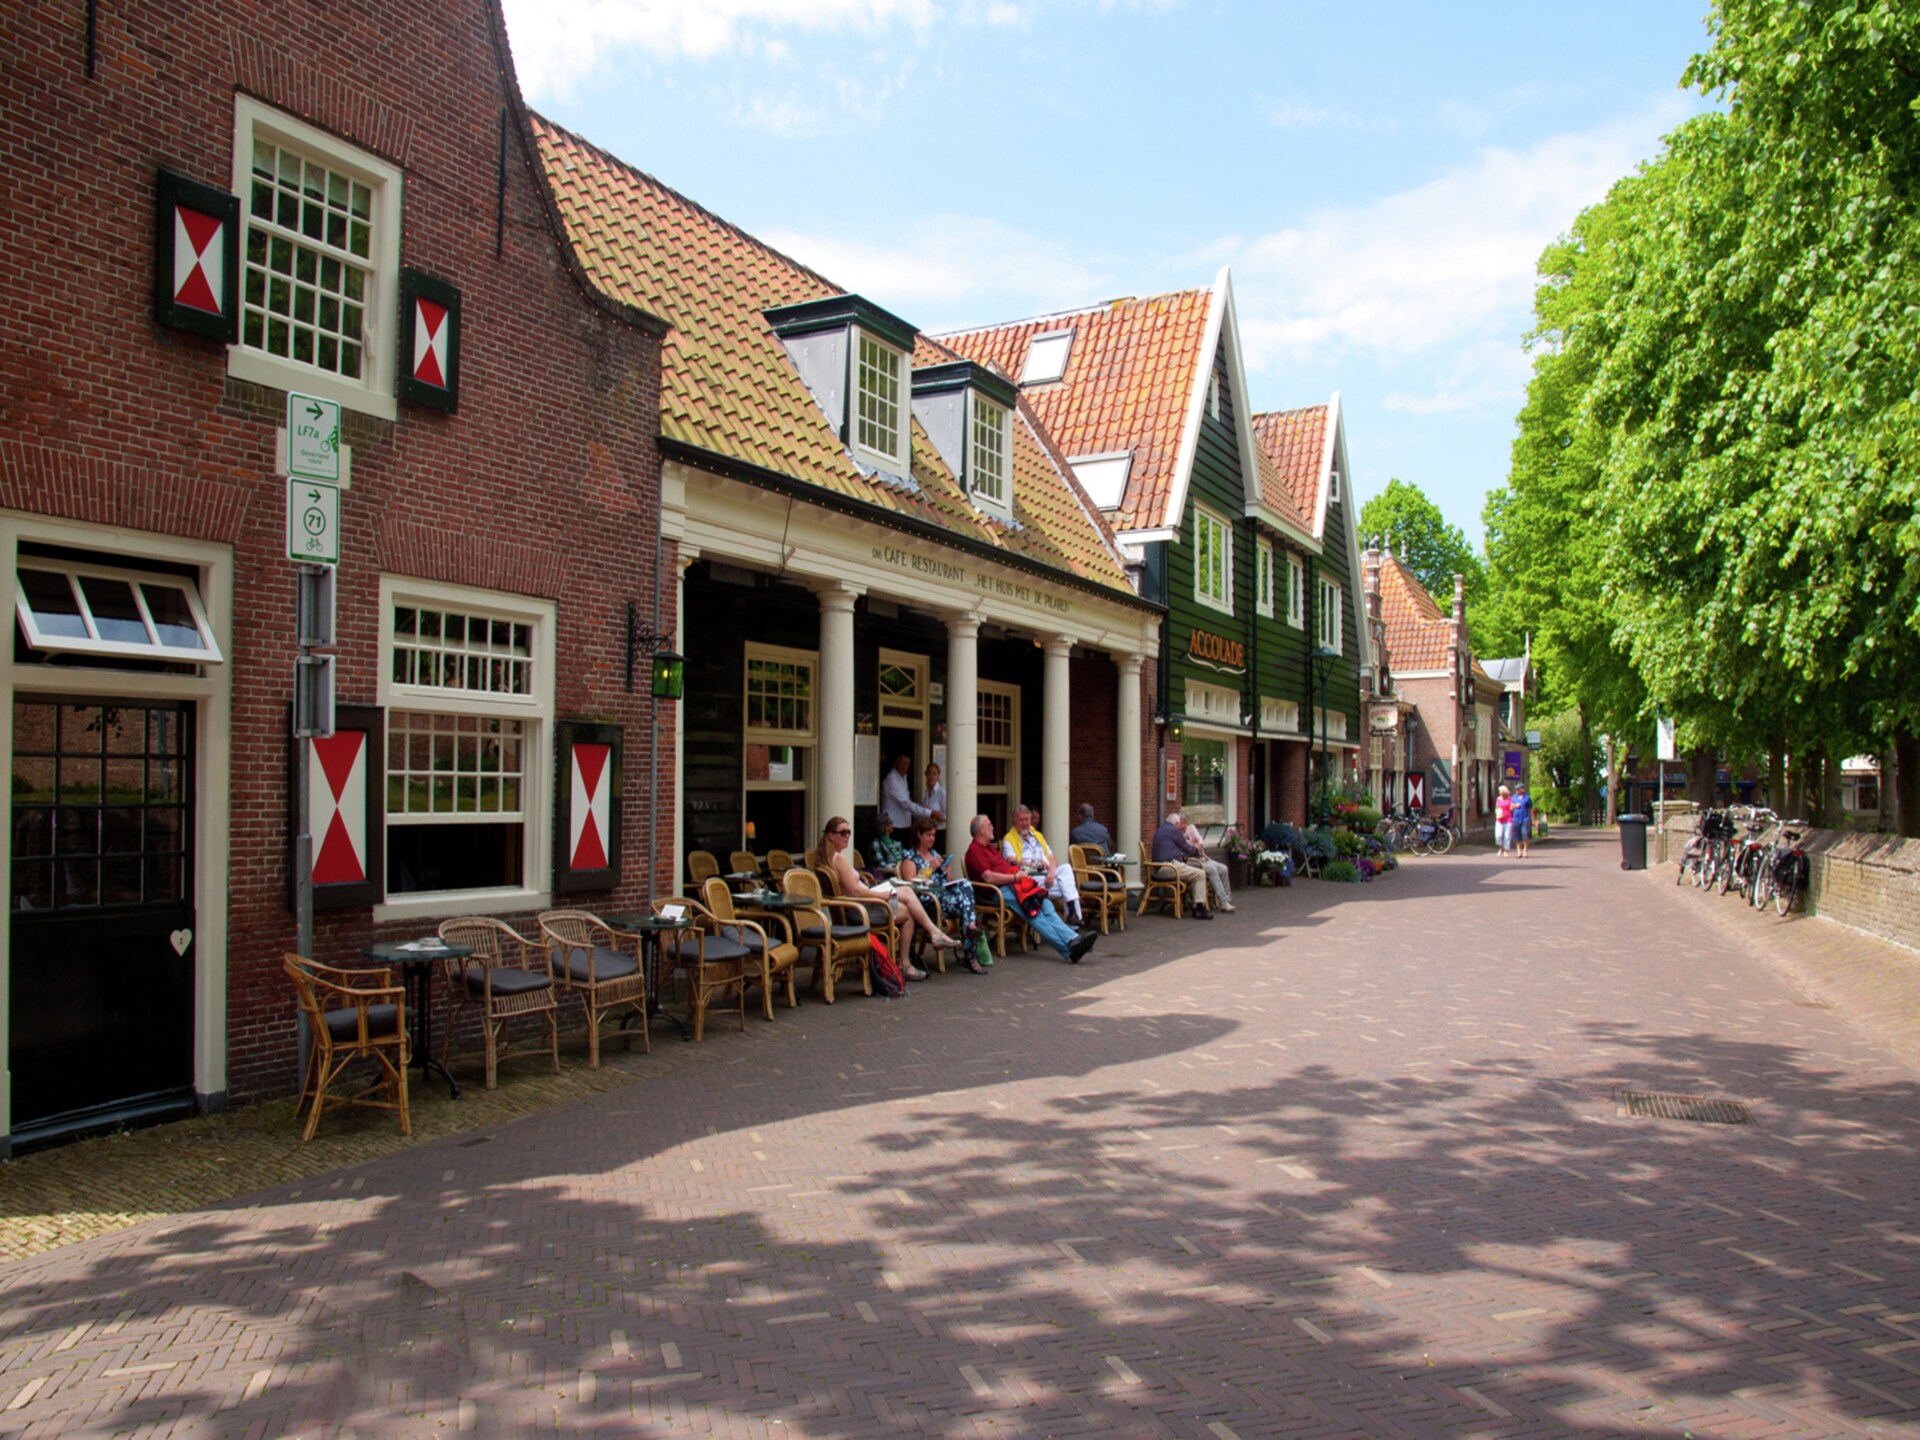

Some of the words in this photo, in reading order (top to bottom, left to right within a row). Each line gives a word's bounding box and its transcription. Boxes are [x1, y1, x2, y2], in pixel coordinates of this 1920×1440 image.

[297, 424, 320, 439] LF7a
[308, 514, 321, 529] 71
[911, 554, 965, 583] RESTAURANT
[996, 578, 1014, 597] HUIS
[1015, 585, 1030, 601] MET
[1034, 590, 1043, 605] DE
[1189, 628, 1244, 667] ACCOLADE
